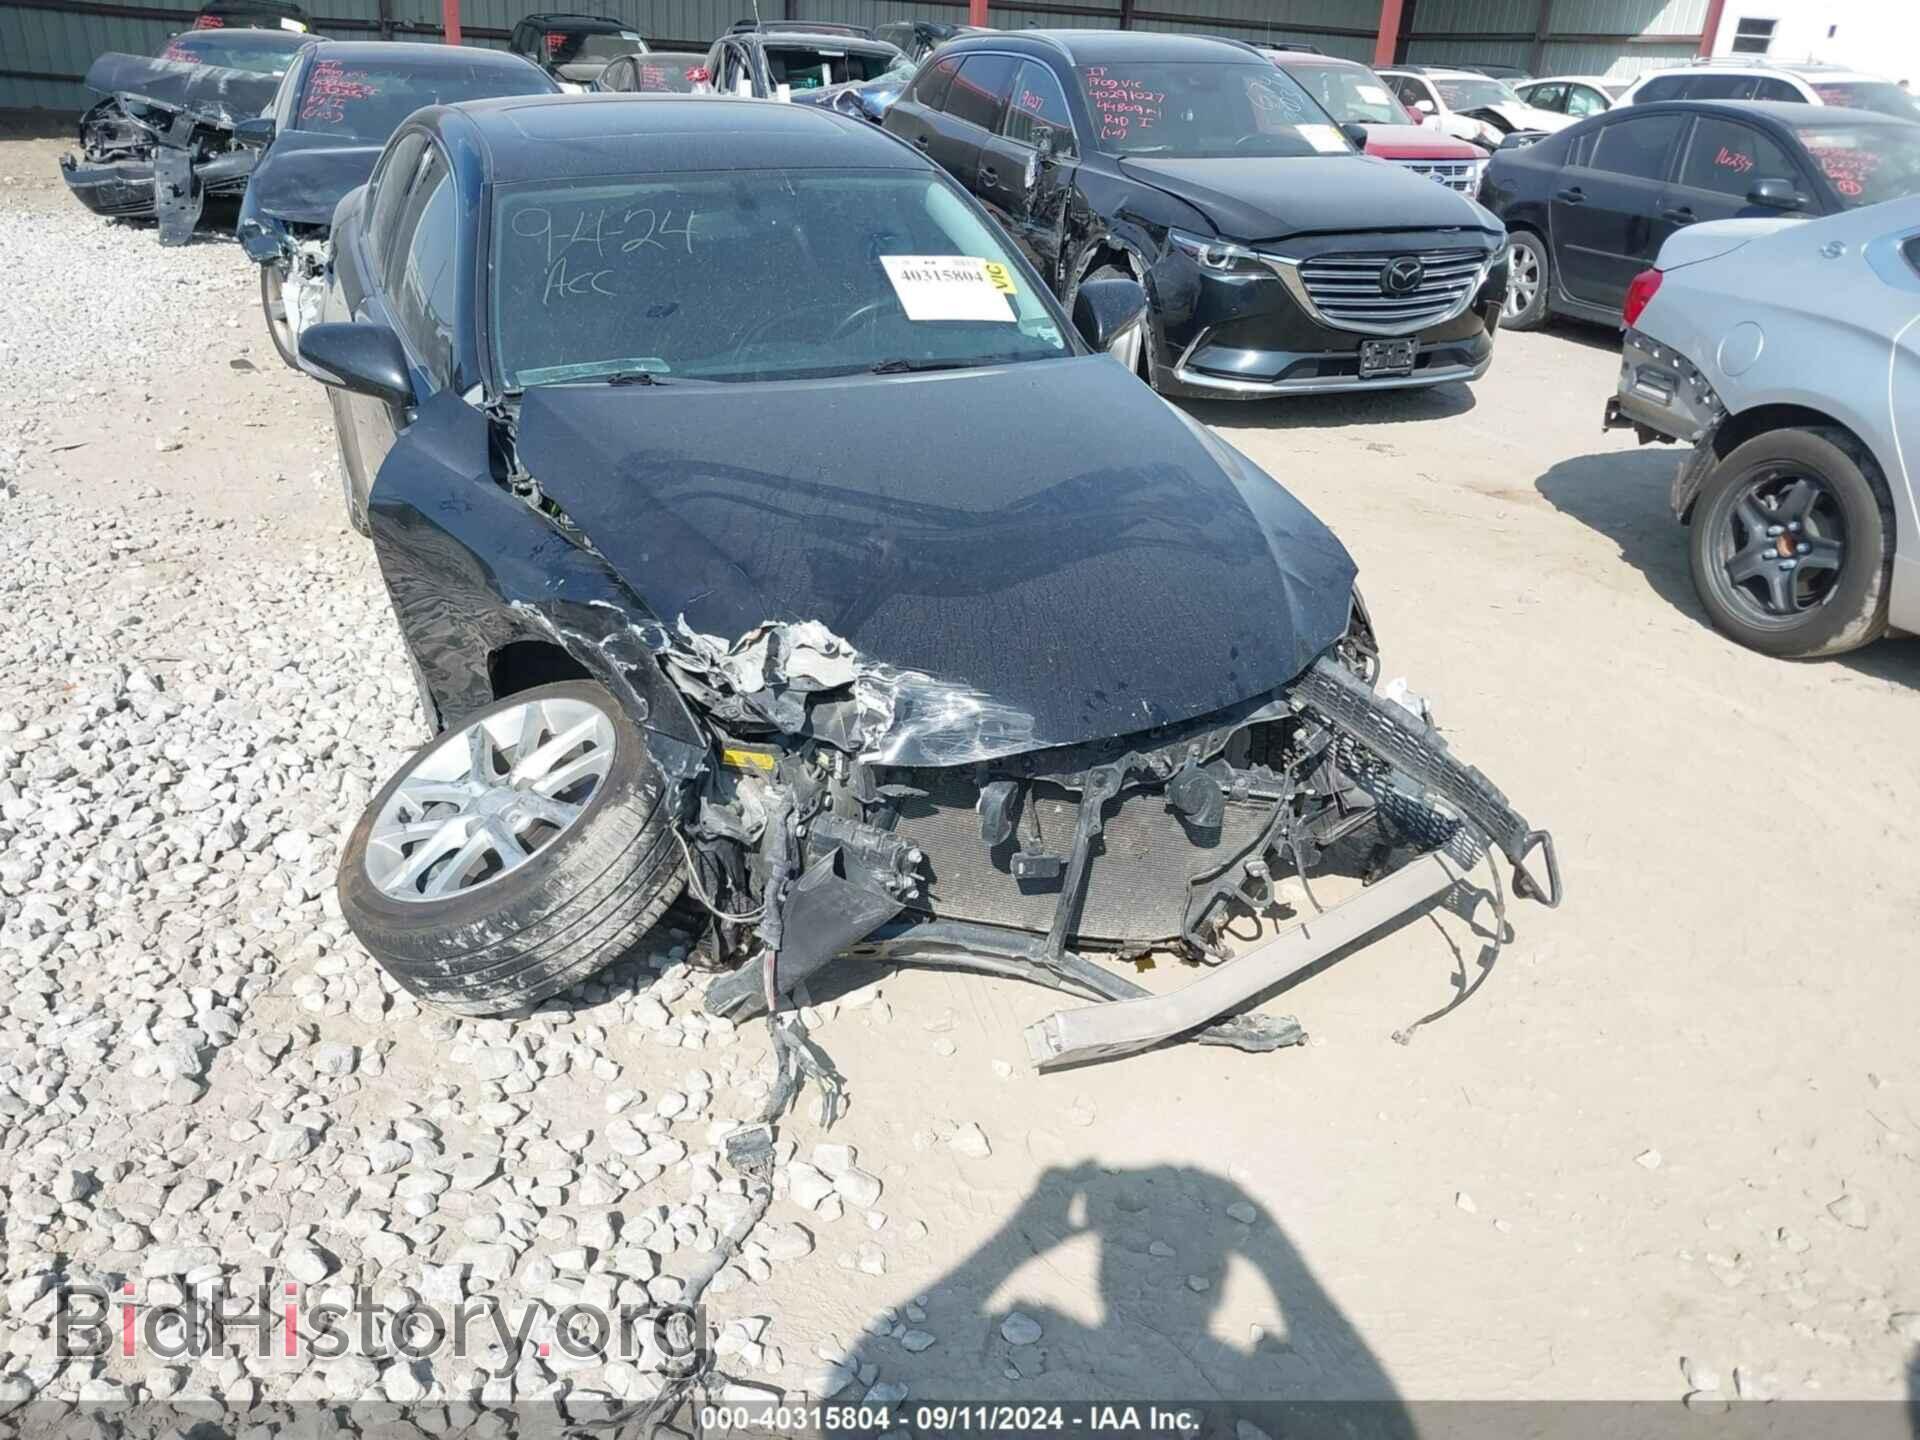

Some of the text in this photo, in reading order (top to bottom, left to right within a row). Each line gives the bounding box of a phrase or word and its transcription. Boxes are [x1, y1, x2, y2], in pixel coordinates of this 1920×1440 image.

[1088, 89, 1165, 103] 40291027
[512, 207, 699, 262] 9-4-24
[902, 269, 983, 282] 40315804
[986, 264, 1009, 290] VIC
